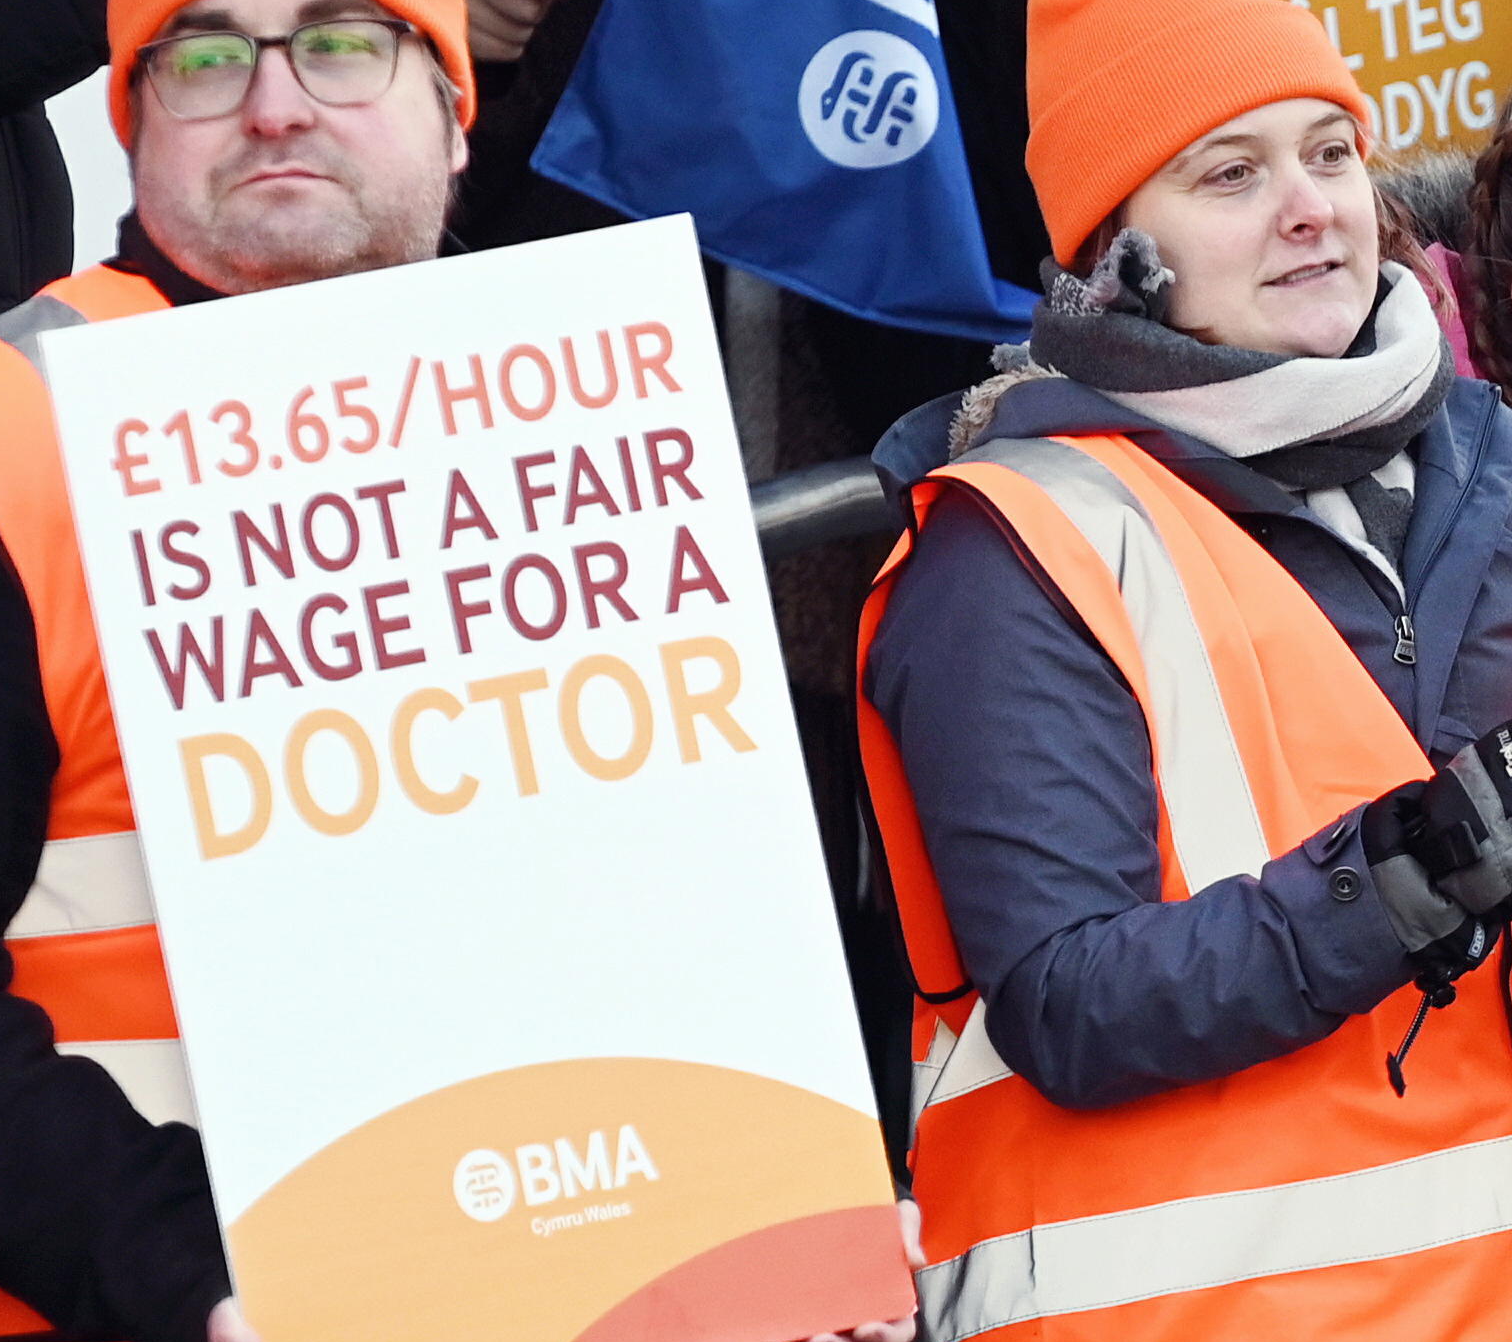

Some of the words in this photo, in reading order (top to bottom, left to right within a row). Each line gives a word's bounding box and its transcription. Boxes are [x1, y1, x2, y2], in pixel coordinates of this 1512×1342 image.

[110, 320, 684, 497] £13.65/HOUR
[129, 519, 211, 607] IS
[231, 479, 408, 587] NOT
[439, 467, 500, 551] A
[513, 426, 705, 534] FAIR
[141, 579, 426, 712] WAGE
[443, 539, 640, 656] FOR
[665, 524, 731, 615] A
[175, 634, 759, 863] DOCTOR
[515, 1124, 661, 1207] BMA
[530, 1211, 584, 1238] Cymru
[585, 1201, 632, 1224] Wales
